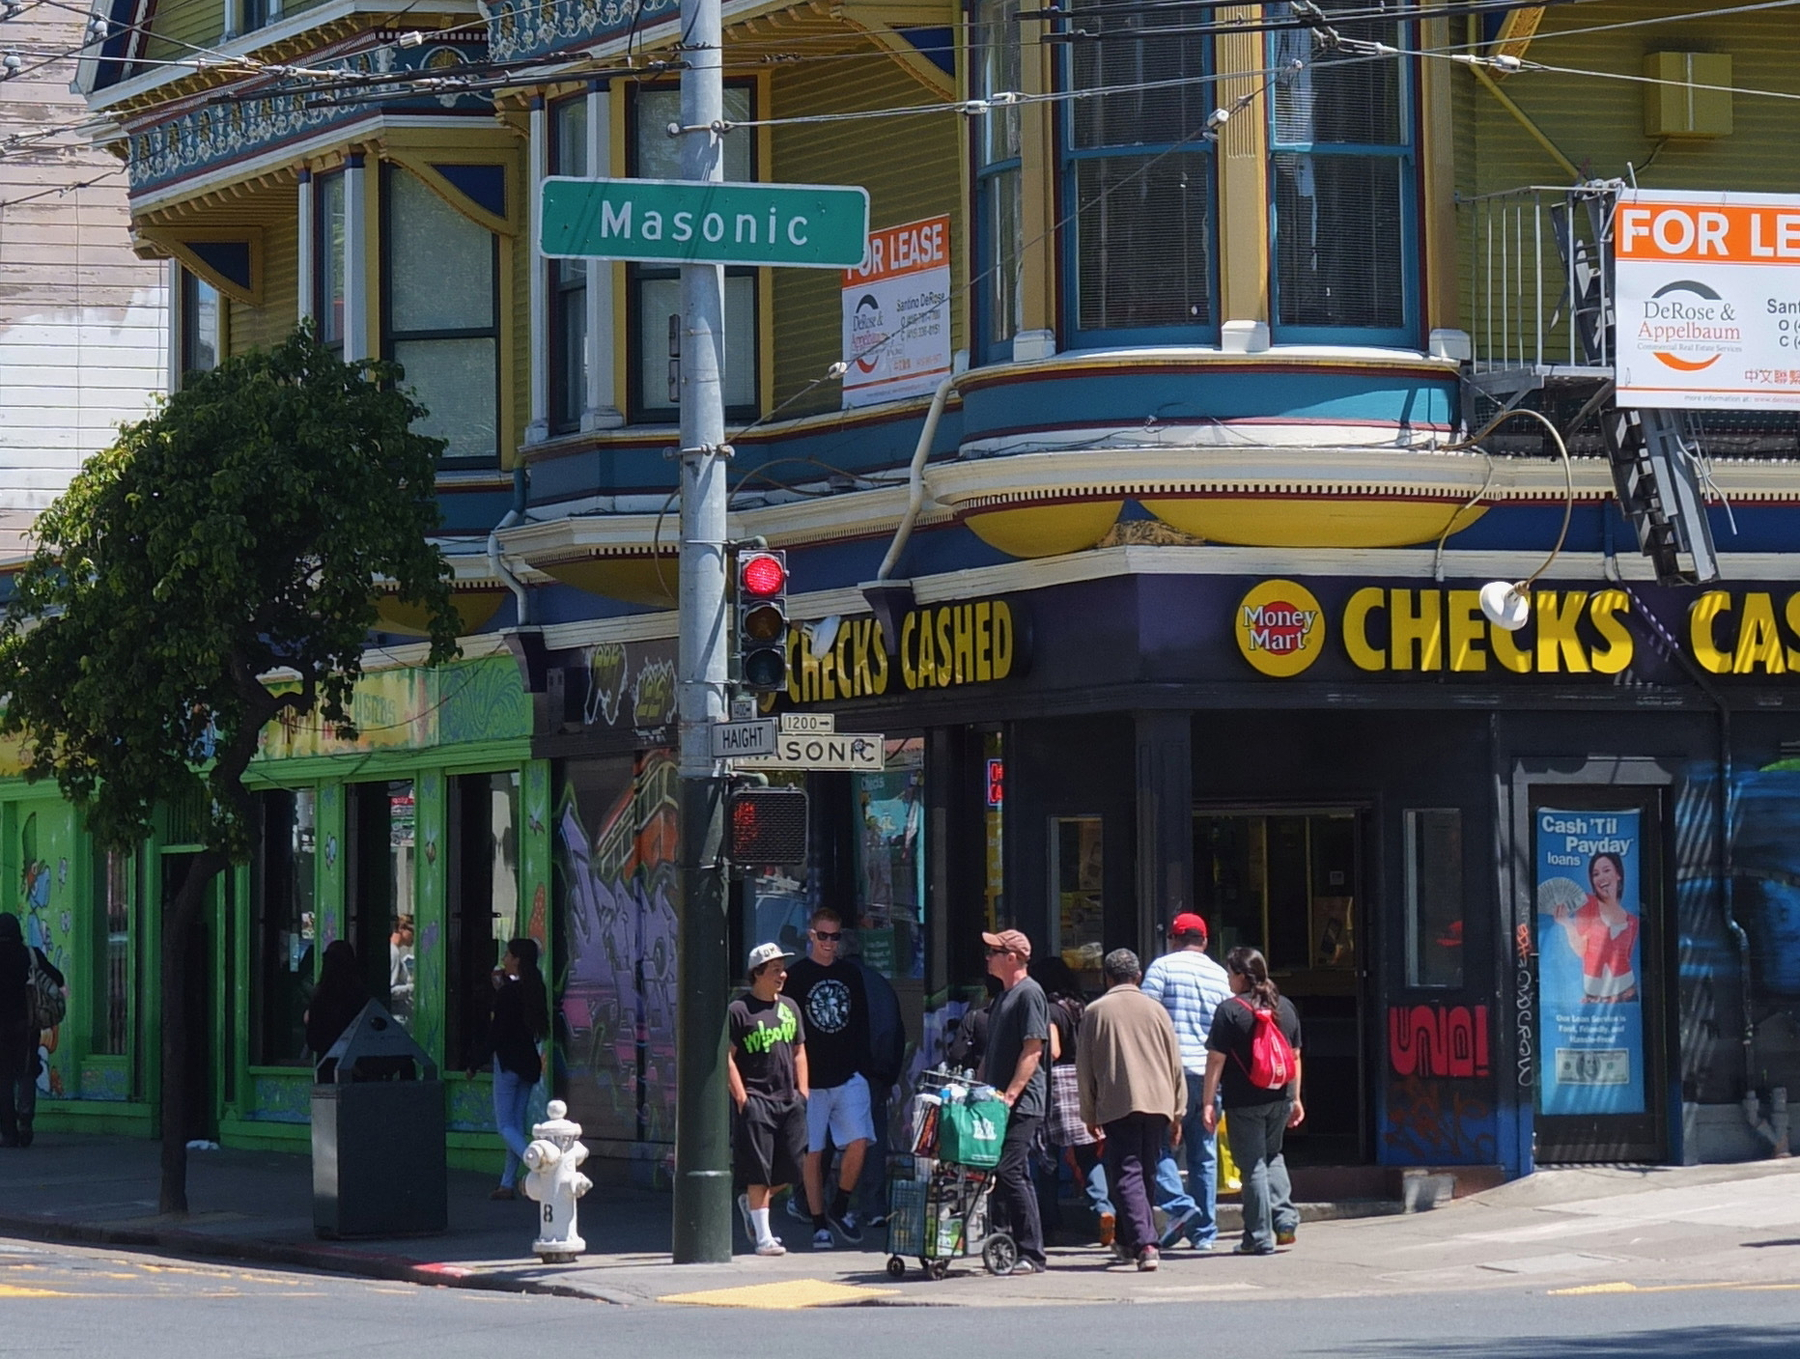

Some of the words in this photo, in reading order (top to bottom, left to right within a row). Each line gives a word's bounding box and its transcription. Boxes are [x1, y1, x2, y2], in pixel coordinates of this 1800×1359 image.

[601, 200, 808, 246] Masonic
[1622, 209, 1730, 256] FOR
[847, 238, 884, 280] OR
[890, 223, 943, 270] LEASE
[1643, 301, 1715, 320] DeRose
[1720, 303, 1736, 321] &
[1638, 320, 1741, 342] Appelbaum
[1637, 342, 1677, 351] Commercial
[1679, 343, 1694, 351] Real
[1695, 344, 1714, 352] Estate
[1716, 344, 1742, 353] Services
[1242, 605, 1318, 634] Money
[1343, 587, 1633, 675] CHECKS
[1248, 628, 1306, 651] Mart
[787, 618, 888, 704] CHECKS
[901, 600, 1013, 690] CASHED
[787, 717, 818, 730] 1200
[722, 727, 764, 750] HAIGHT
[750, 739, 875, 762] SONIC
[1541, 815, 1587, 834] Cash
[1589, 818, 1617, 834] 'Til
[1565, 836, 1632, 857] Payday
[1547, 851, 1581, 866] loans
[543, 1203, 553, 1223] 8
